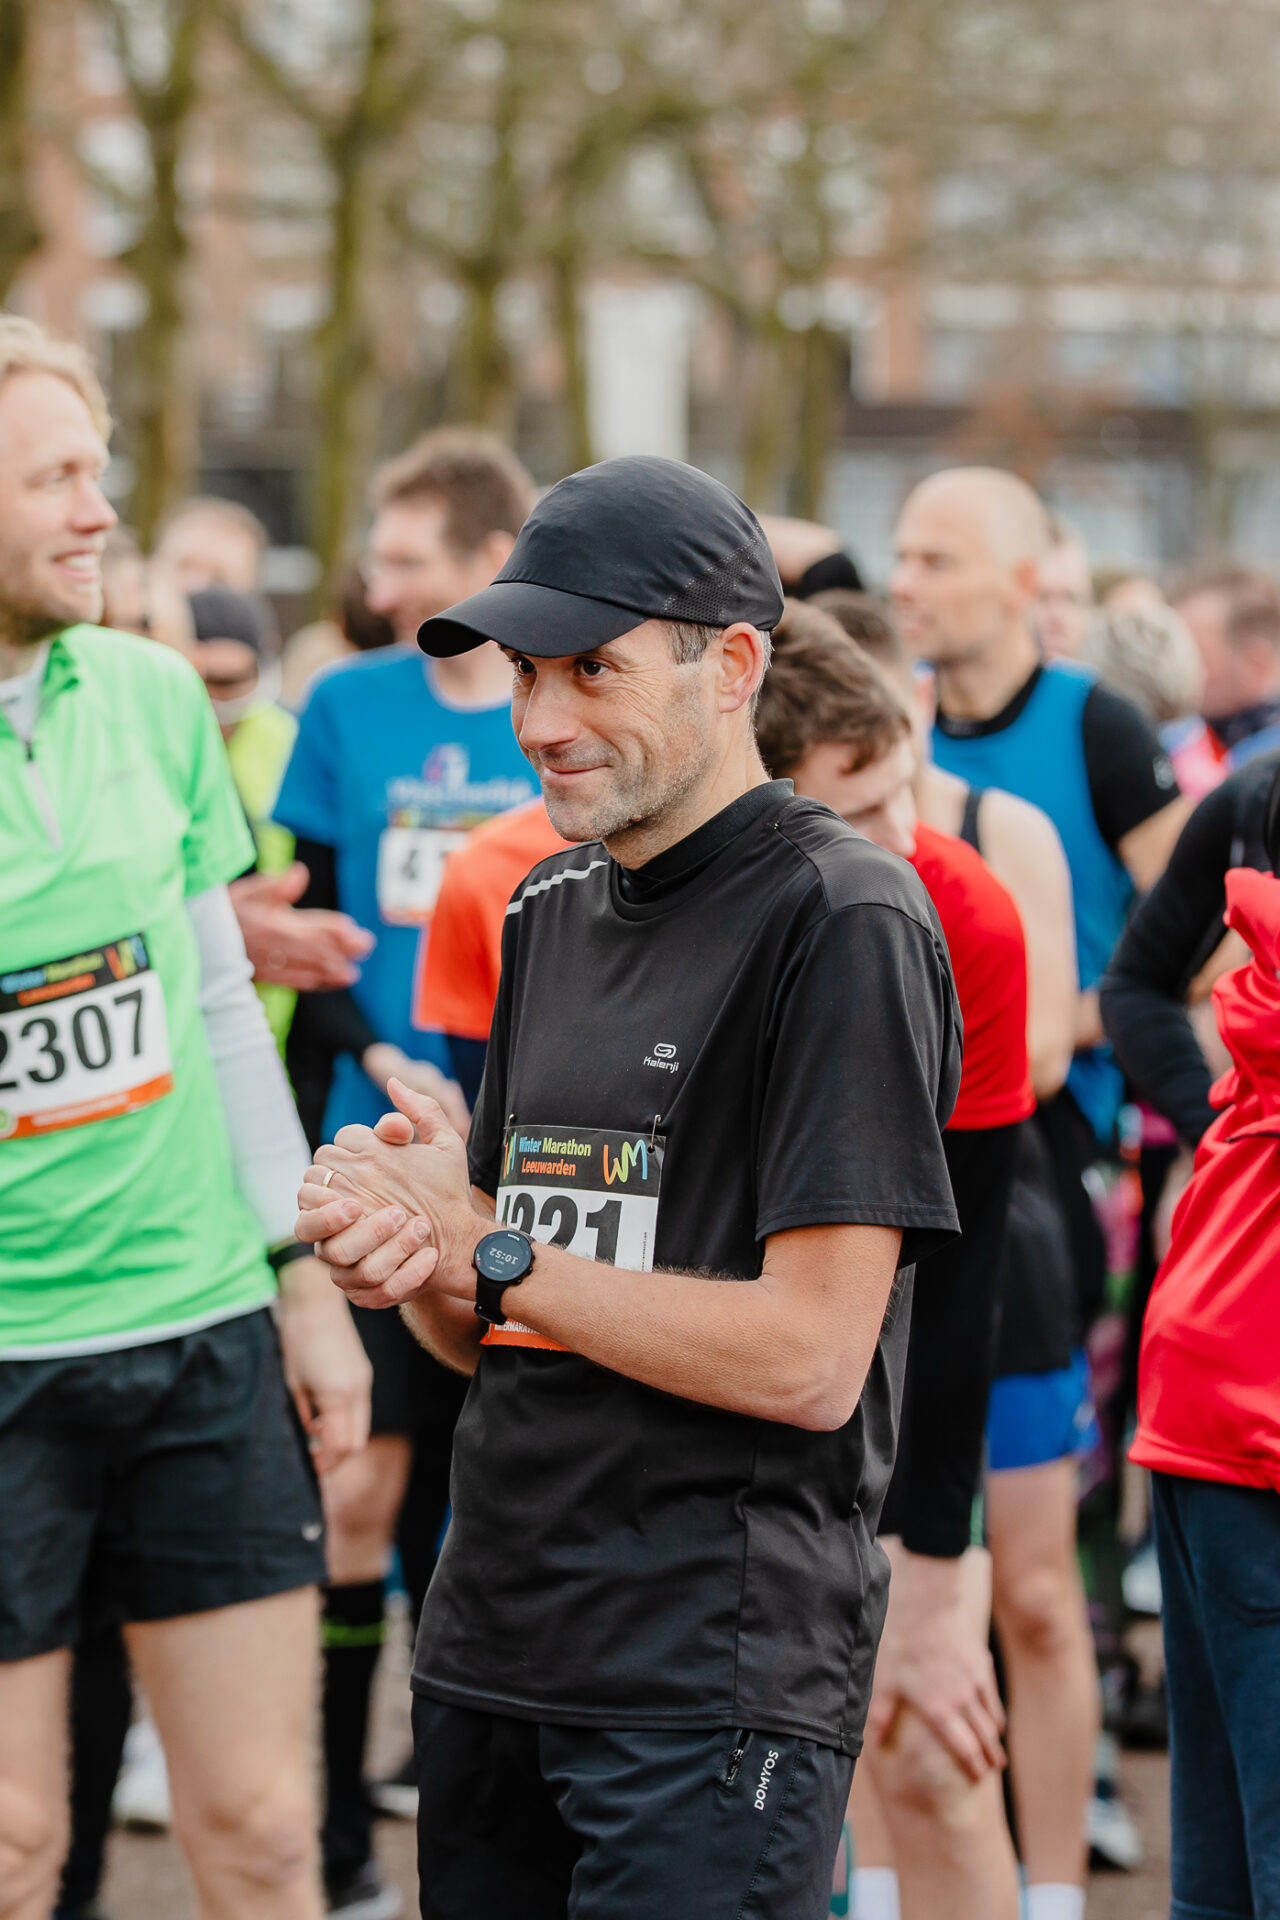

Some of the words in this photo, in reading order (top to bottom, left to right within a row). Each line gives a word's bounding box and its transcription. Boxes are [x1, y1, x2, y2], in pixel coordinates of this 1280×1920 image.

[643, 1056, 679, 1073] Kalenji
[518, 1136, 541, 1153] Winter
[541, 1136, 592, 1157] Marathon
[521, 1157, 576, 1176] Leeuwarden
[489, 1247, 519, 1265] 10:52
[753, 1749, 780, 1811] DOMYOS
